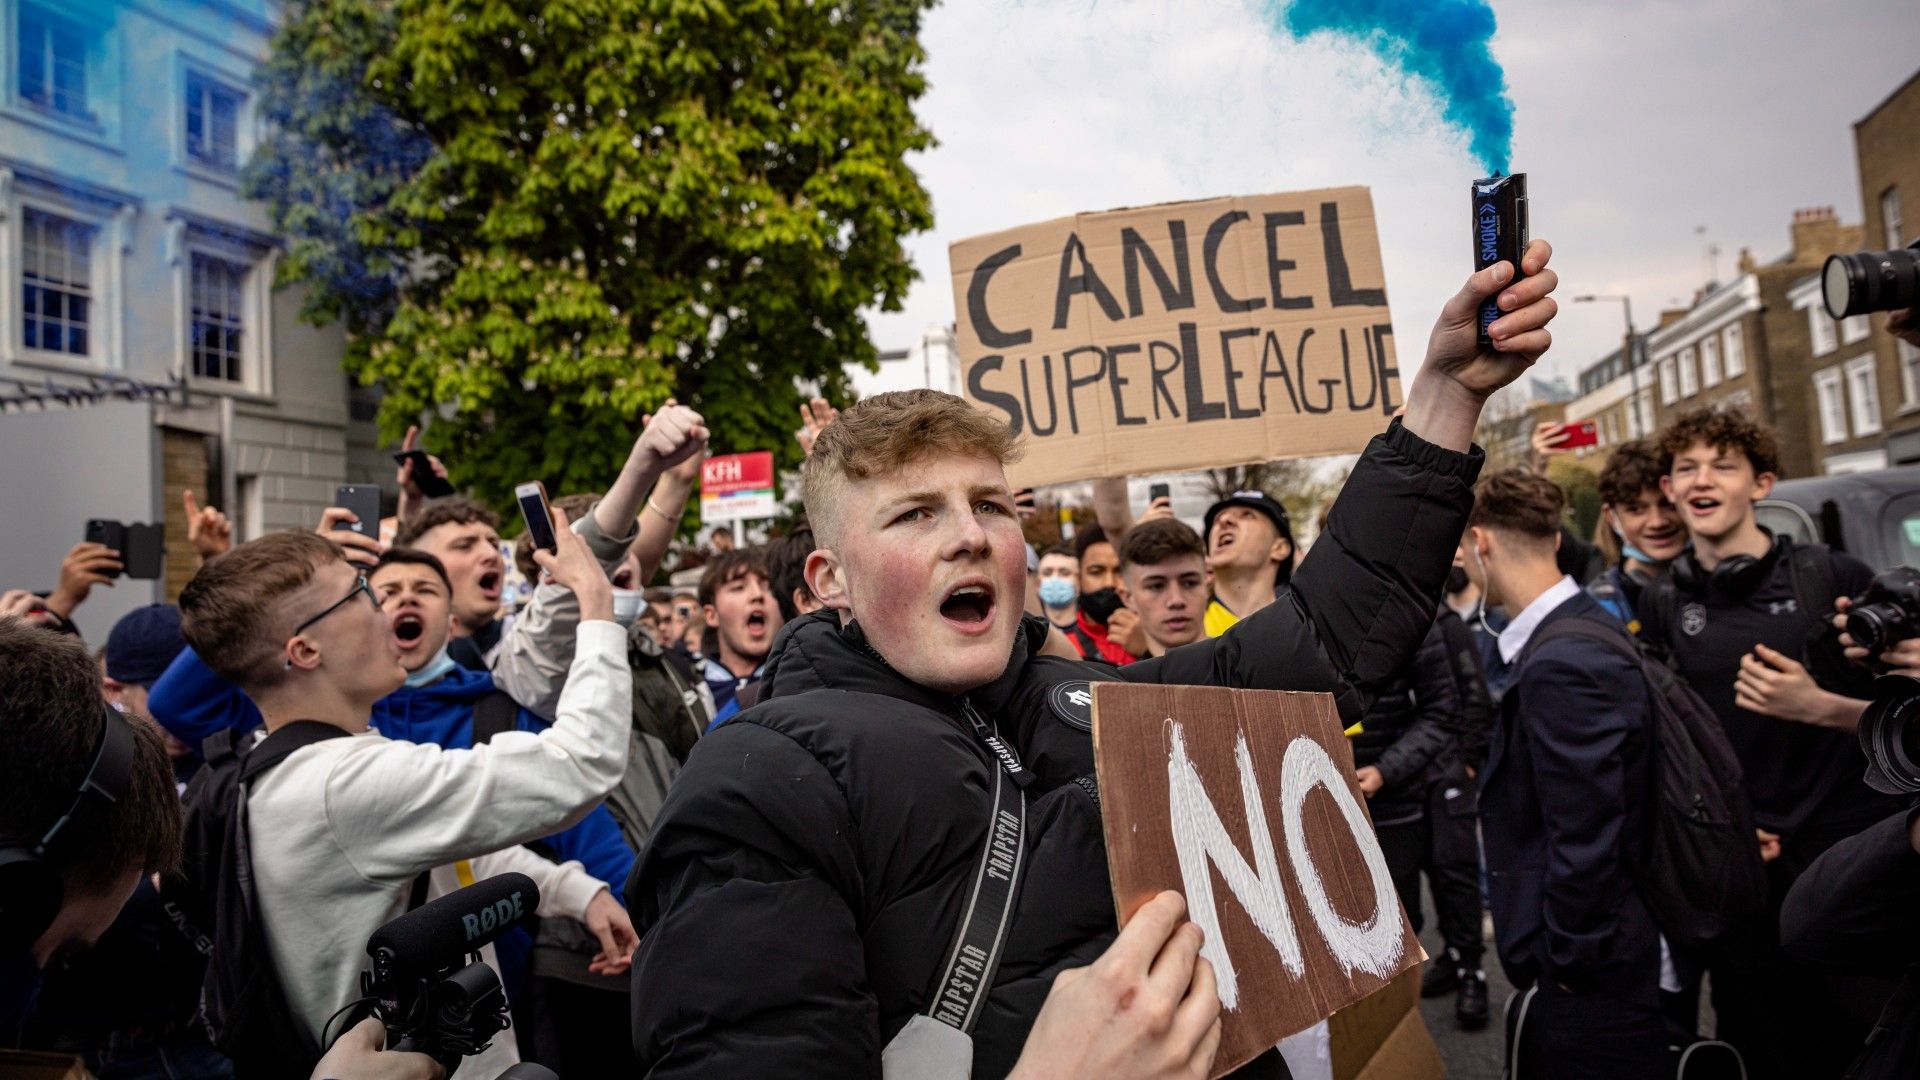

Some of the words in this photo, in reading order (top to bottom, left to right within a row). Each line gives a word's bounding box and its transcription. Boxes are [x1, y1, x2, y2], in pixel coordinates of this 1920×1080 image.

[1481, 215, 1497, 261] SMOKE
[967, 202, 1387, 349] CANCEL
[967, 321, 1402, 438] SUPERLEAGUE
[703, 459, 742, 483] KFH
[985, 736, 1022, 773] TRAPSTAR
[987, 810, 1021, 881] TRAPSTAR
[1162, 719, 1404, 1012] NO
[461, 891, 525, 941] RØDE
[935, 945, 987, 1027] RAPSTAR
